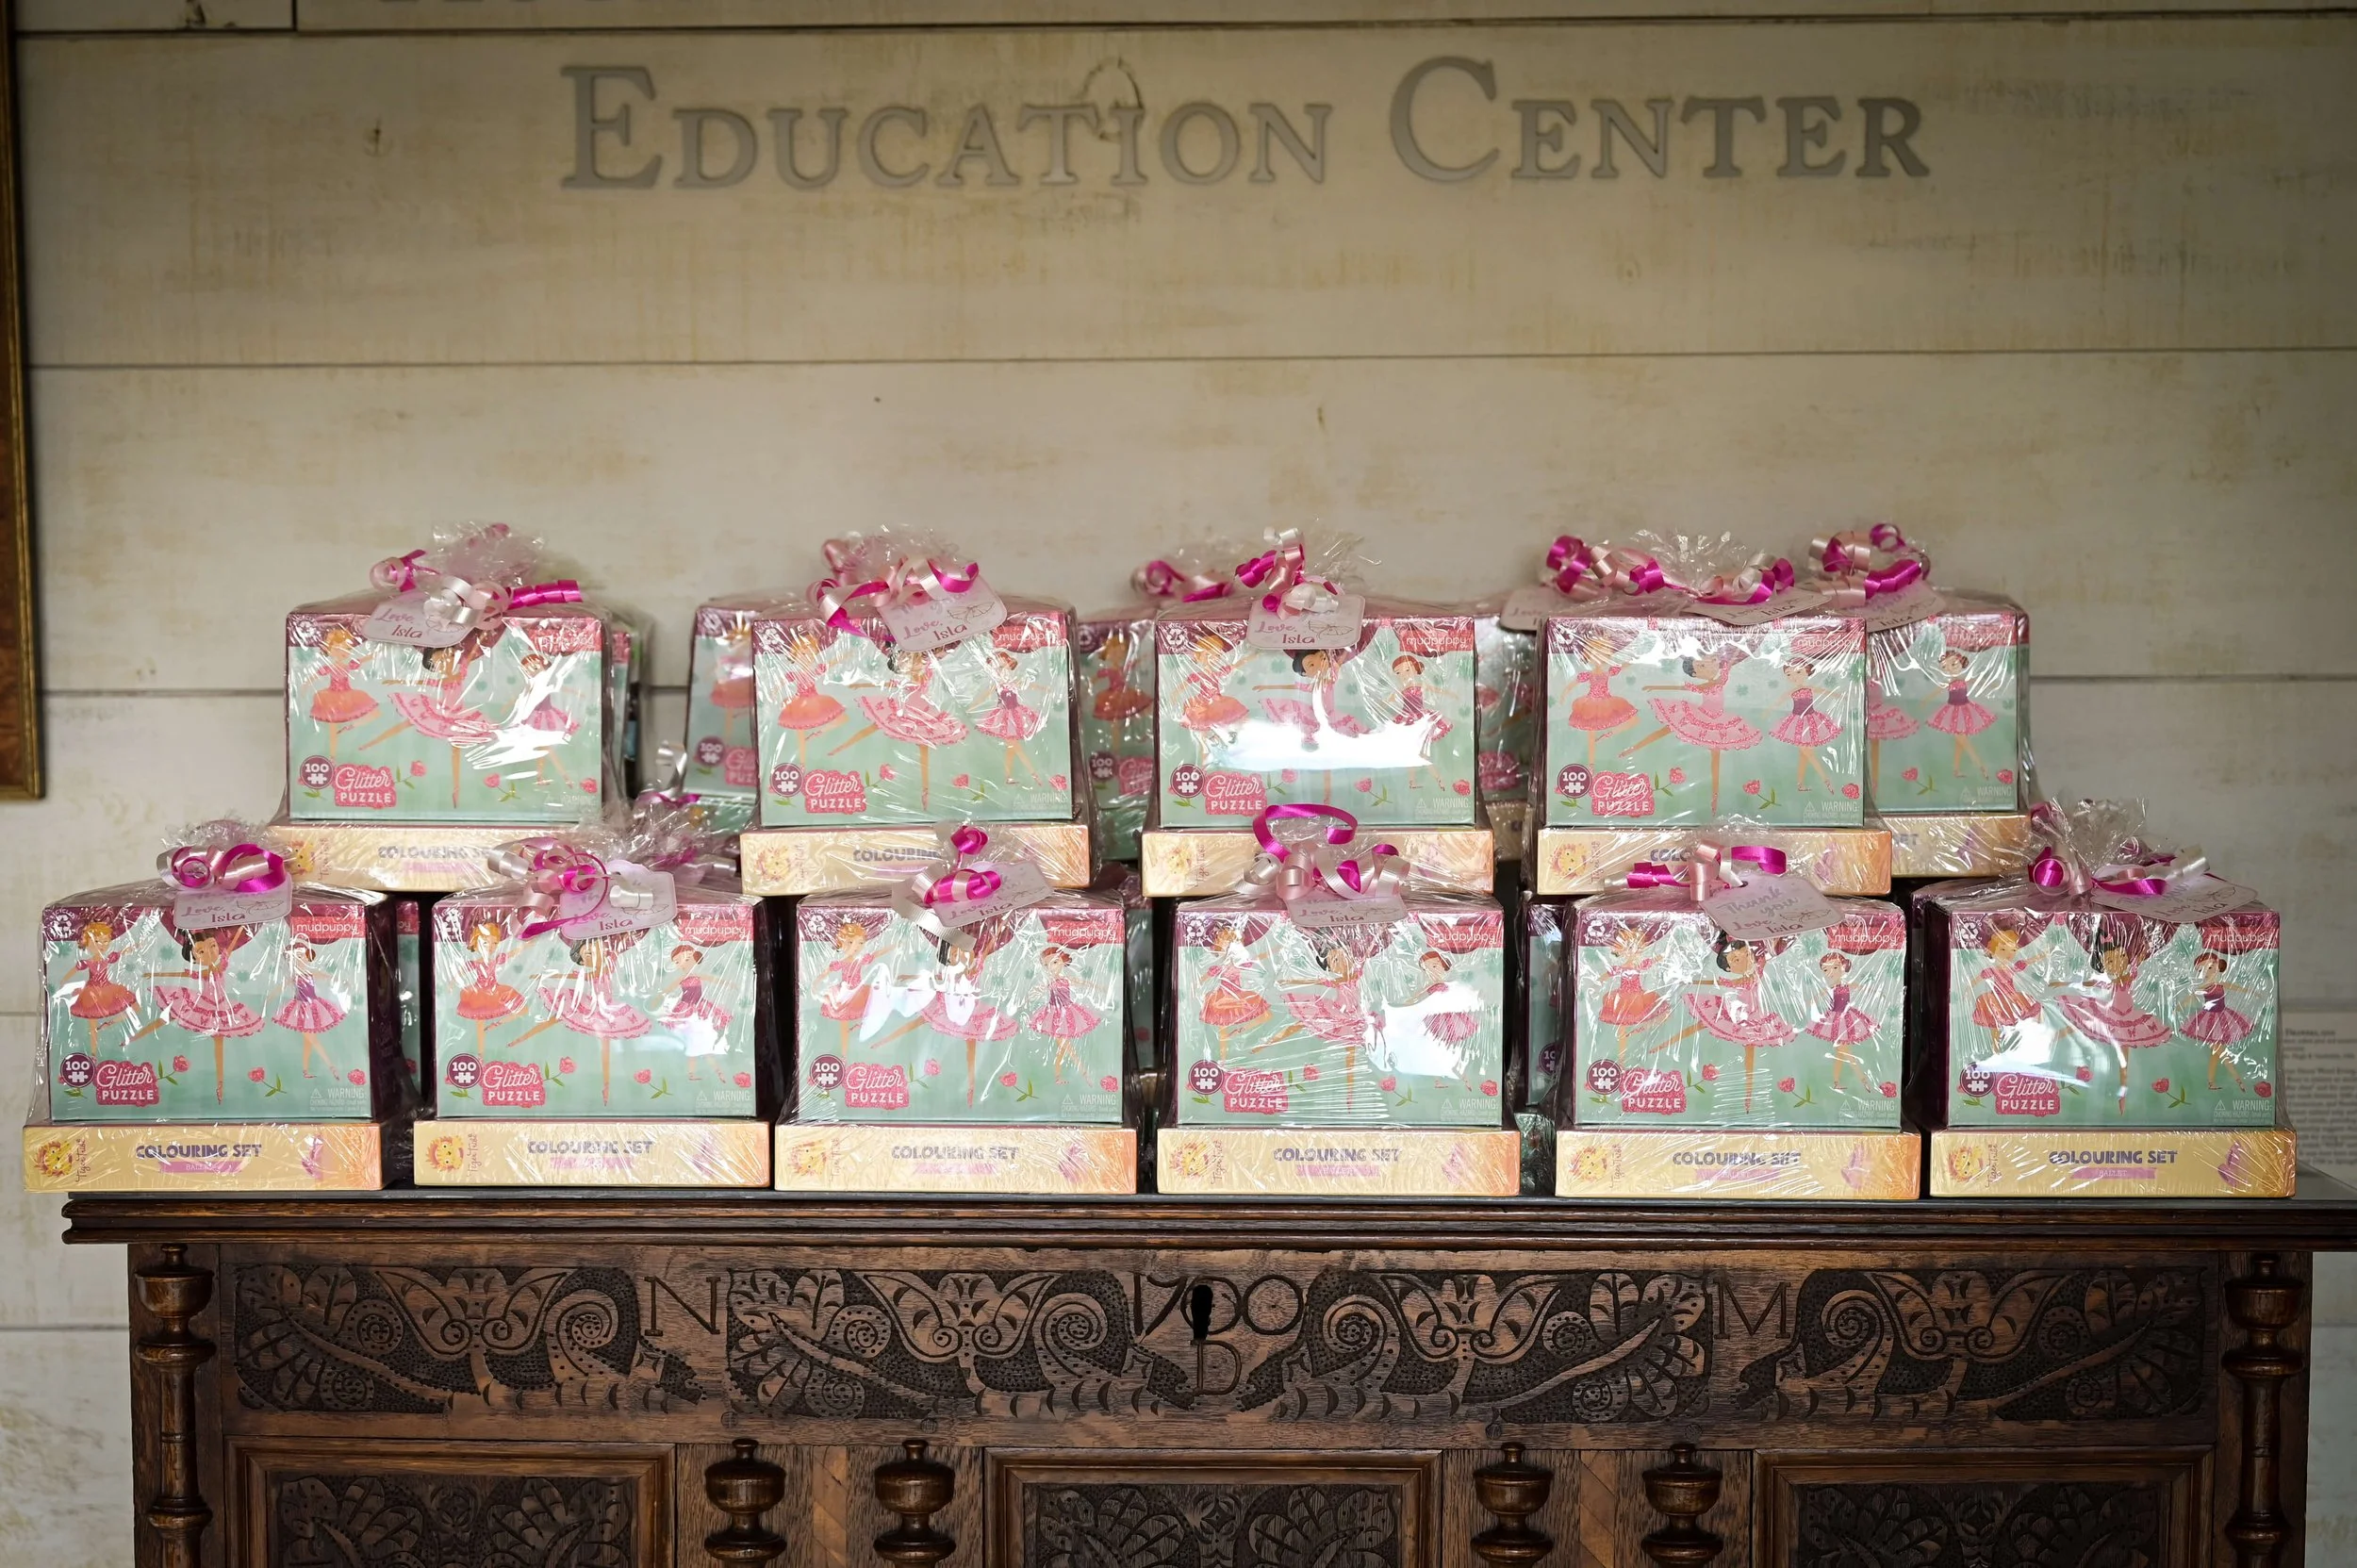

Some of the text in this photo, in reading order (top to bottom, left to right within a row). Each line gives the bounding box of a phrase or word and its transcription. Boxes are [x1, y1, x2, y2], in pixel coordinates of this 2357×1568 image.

[560, 56, 1930, 189] EDUCATION CENTER
[391, 624, 422, 638] Isla
[903, 619, 943, 639] Love,
[933, 624, 967, 641] Isla
[1282, 634, 1315, 644] Isla
[701, 742, 723, 752] 100
[305, 764, 329, 772] 100
[1092, 758, 1113, 767] 100
[335, 767, 390, 790] Glitter
[775, 770, 799, 781] 100
[1175, 772, 1199, 782] 100
[1562, 772, 1587, 782] 100
[804, 773, 860, 797] Glitter
[1206, 775, 1261, 799] Glitter
[340, 793, 391, 802] PUZZLE
[811, 798, 861, 808] PUZZLE
[1211, 801, 1262, 810] PUZZLE
[1597, 801, 1650, 811] PUZZLE
[980, 902, 1014, 916] Isla
[1759, 897, 1799, 916] you
[210, 912, 246, 924] Isla
[296, 922, 357, 936] mudpuppy
[600, 919, 633, 932] Isla
[684, 925, 746, 937] mudpuppy
[1766, 923, 1804, 933] Isla
[1835, 933, 1897, 946] mudpuppy
[1544, 1050, 1556, 1059] 10
[66, 1061, 90, 1070] 100
[453, 1062, 476, 1071] 100
[816, 1063, 839, 1072] 100
[97, 1064, 153, 1088] Glitter
[484, 1065, 539, 1089] Glitter
[1194, 1067, 1218, 1077] 100
[1592, 1067, 1616, 1077] 100
[1966, 1070, 1989, 1080] 100
[847, 1066, 902, 1091] Glitter
[1997, 1074, 2054, 1098] Glitter
[103, 1090, 154, 1100] PUZZLE
[488, 1091, 540, 1100] PUZZLE
[851, 1093, 904, 1102] PUZZLE
[1230, 1098, 1282, 1108] PUZZLE
[1628, 1098, 1681, 1109] PUZZLE
[2002, 1099, 2054, 1110] PUZZLE
[2233, 1099, 2272, 1111] WARNING:
[136, 1144, 262, 1158] COLOURING SET
[2049, 1150, 2178, 1164] COLOURING SET
[644, 1276, 720, 1336] N
[1714, 1279, 1791, 1339] M
